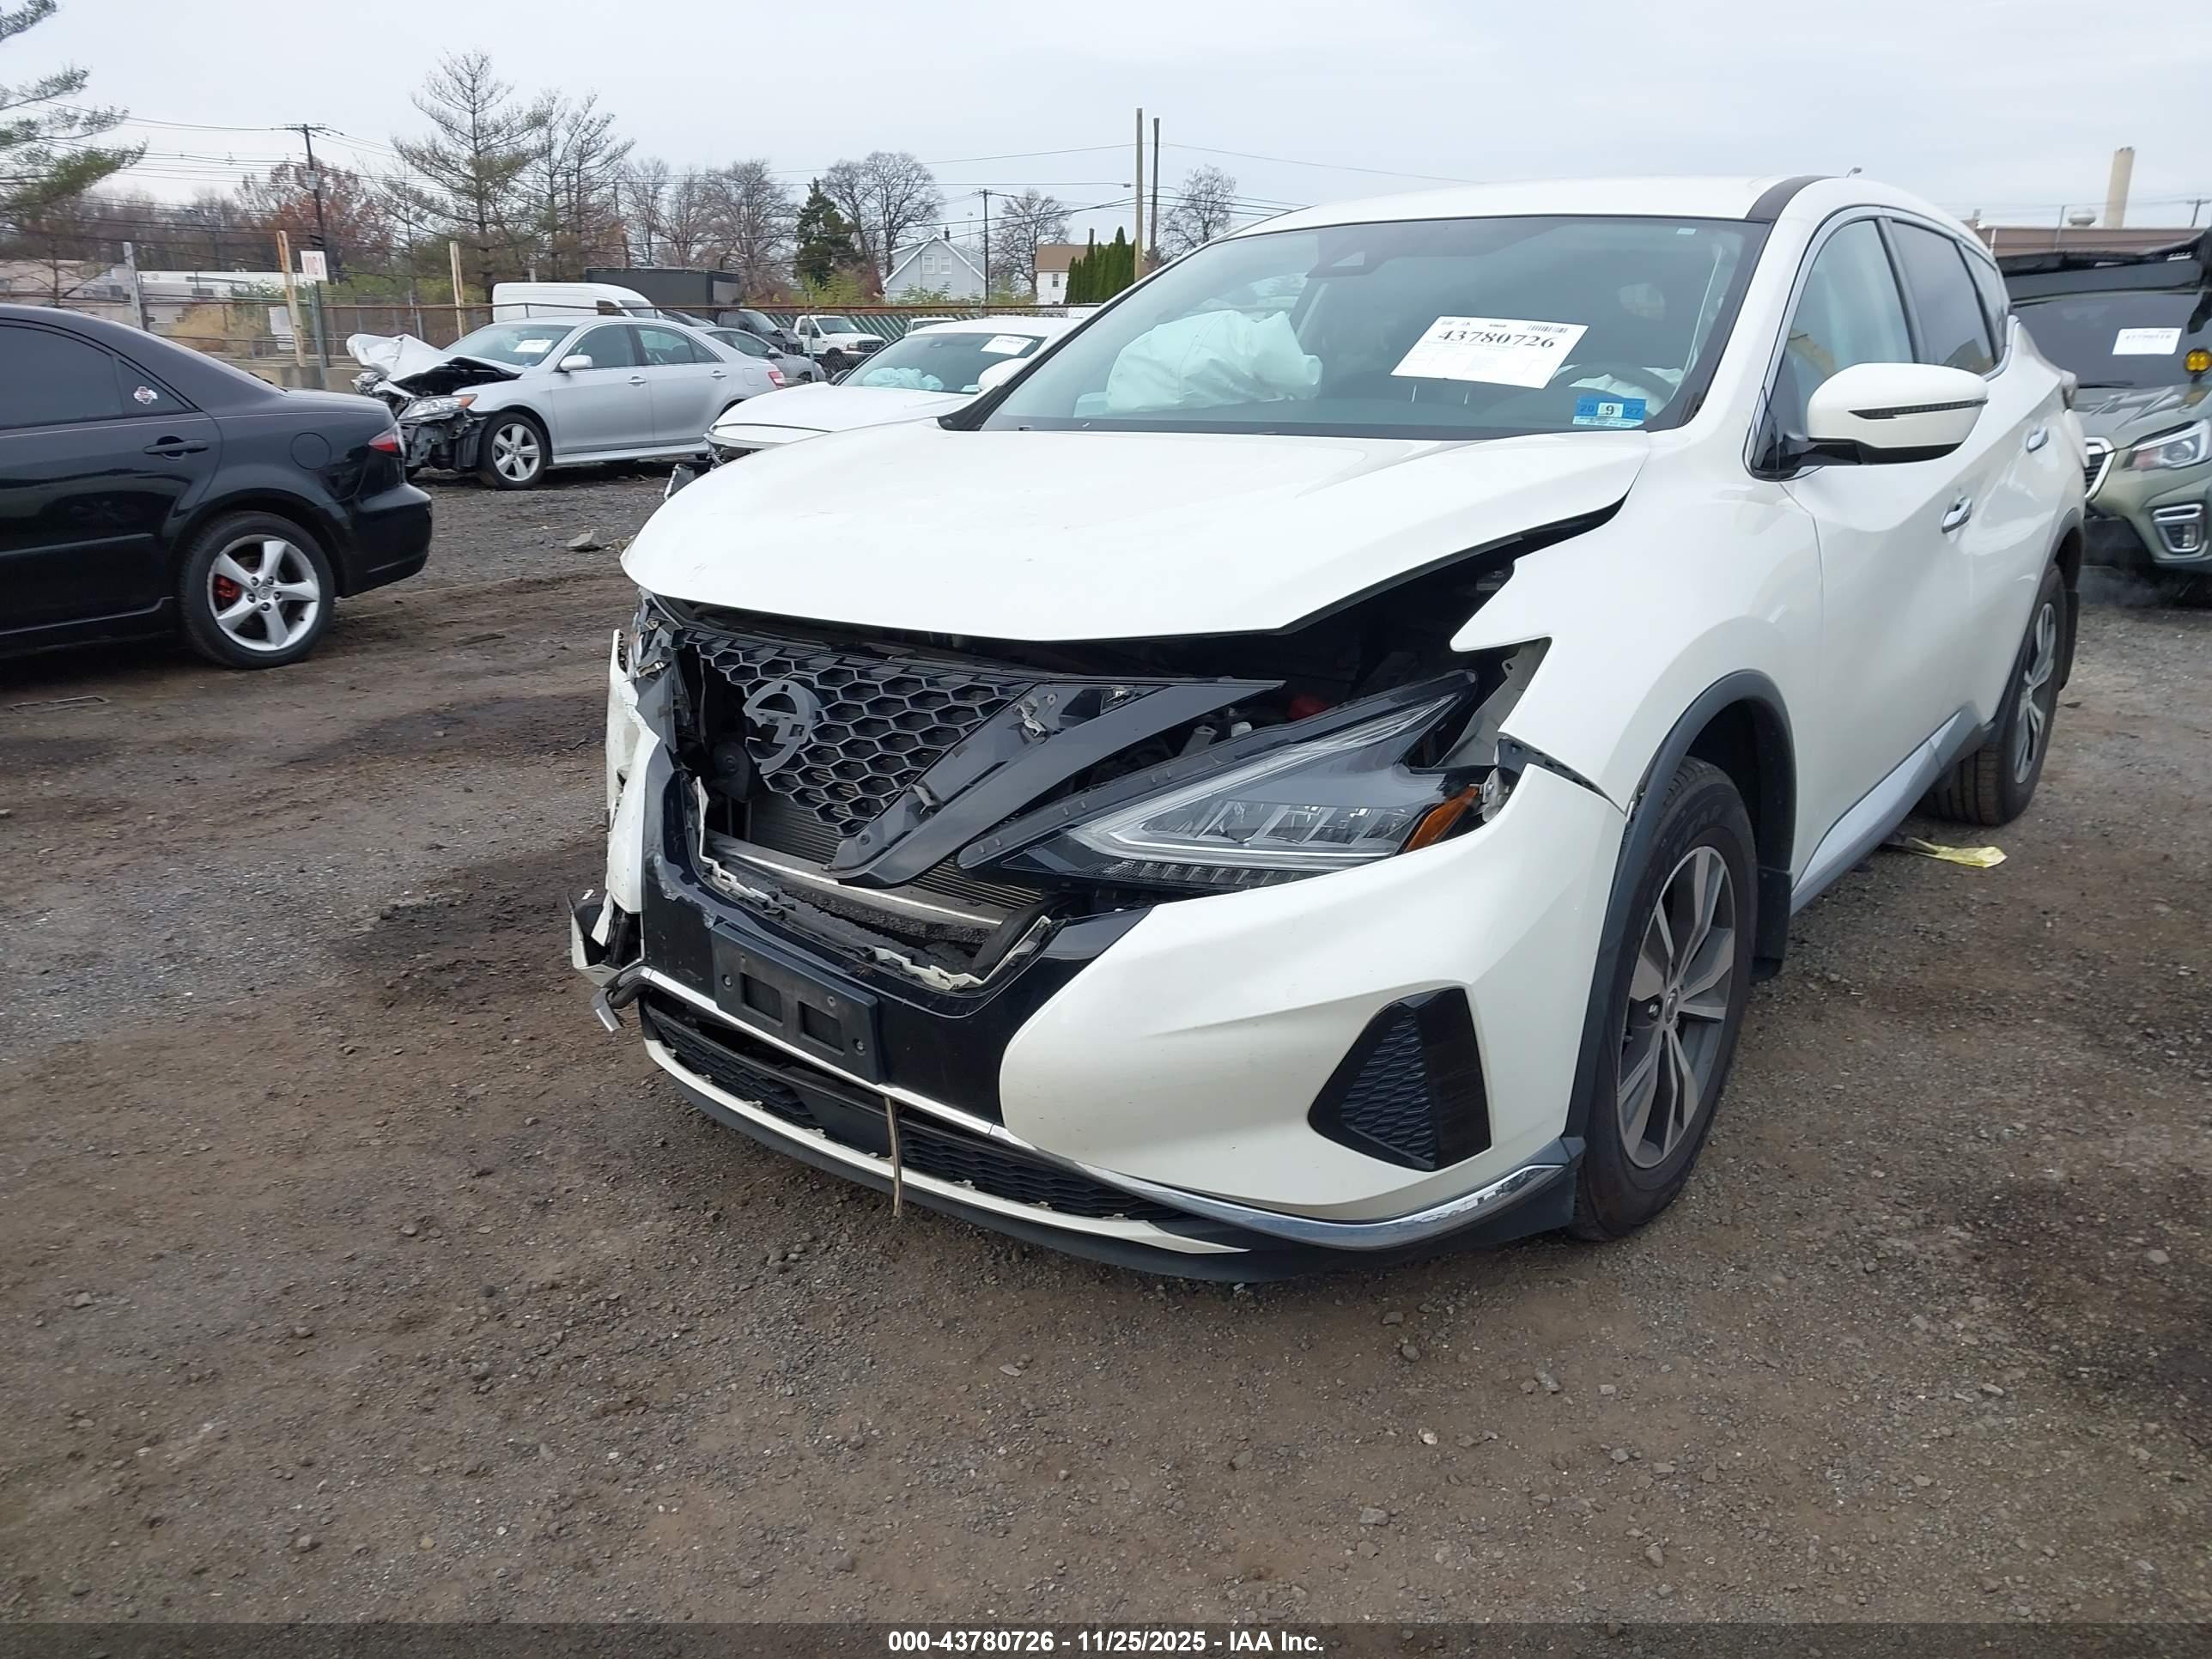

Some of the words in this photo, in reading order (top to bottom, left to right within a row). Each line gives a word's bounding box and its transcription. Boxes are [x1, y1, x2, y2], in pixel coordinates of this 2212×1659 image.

[1437, 330, 1559, 349] 43780726
[1580, 404, 1595, 413] 20
[1606, 404, 1614, 416] 9
